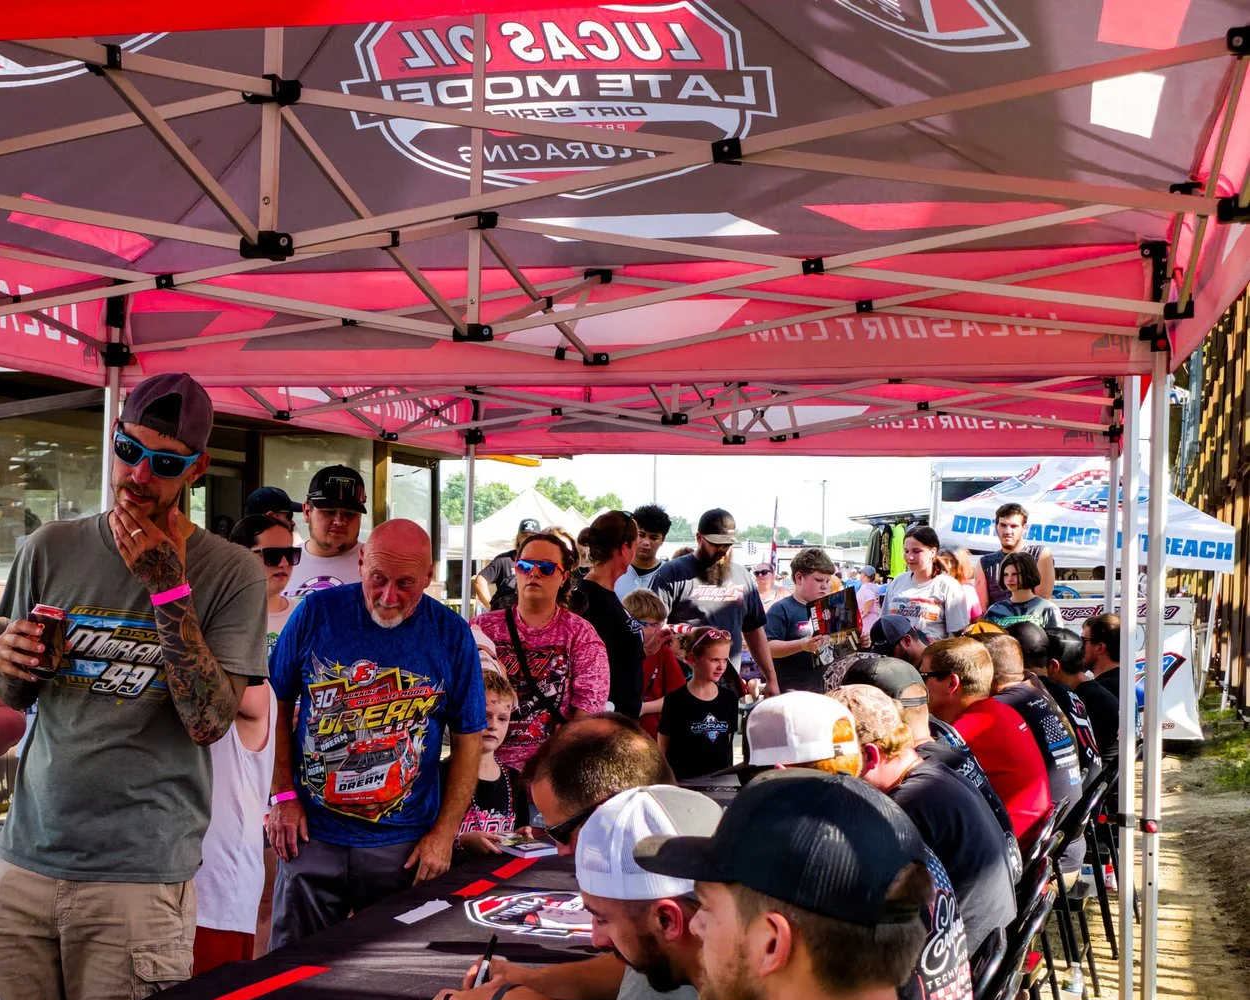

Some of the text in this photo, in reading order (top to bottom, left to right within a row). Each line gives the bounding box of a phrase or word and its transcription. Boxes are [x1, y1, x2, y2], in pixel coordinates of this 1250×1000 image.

[91, 662, 157, 697] 99
[343, 688, 378, 700] RUNNING
[400, 689, 429, 697] MODEL
[317, 694, 439, 735] DREAM
[691, 723, 729, 731] MORAN
[320, 733, 349, 752] DREAM
[338, 773, 385, 792] DREAM
